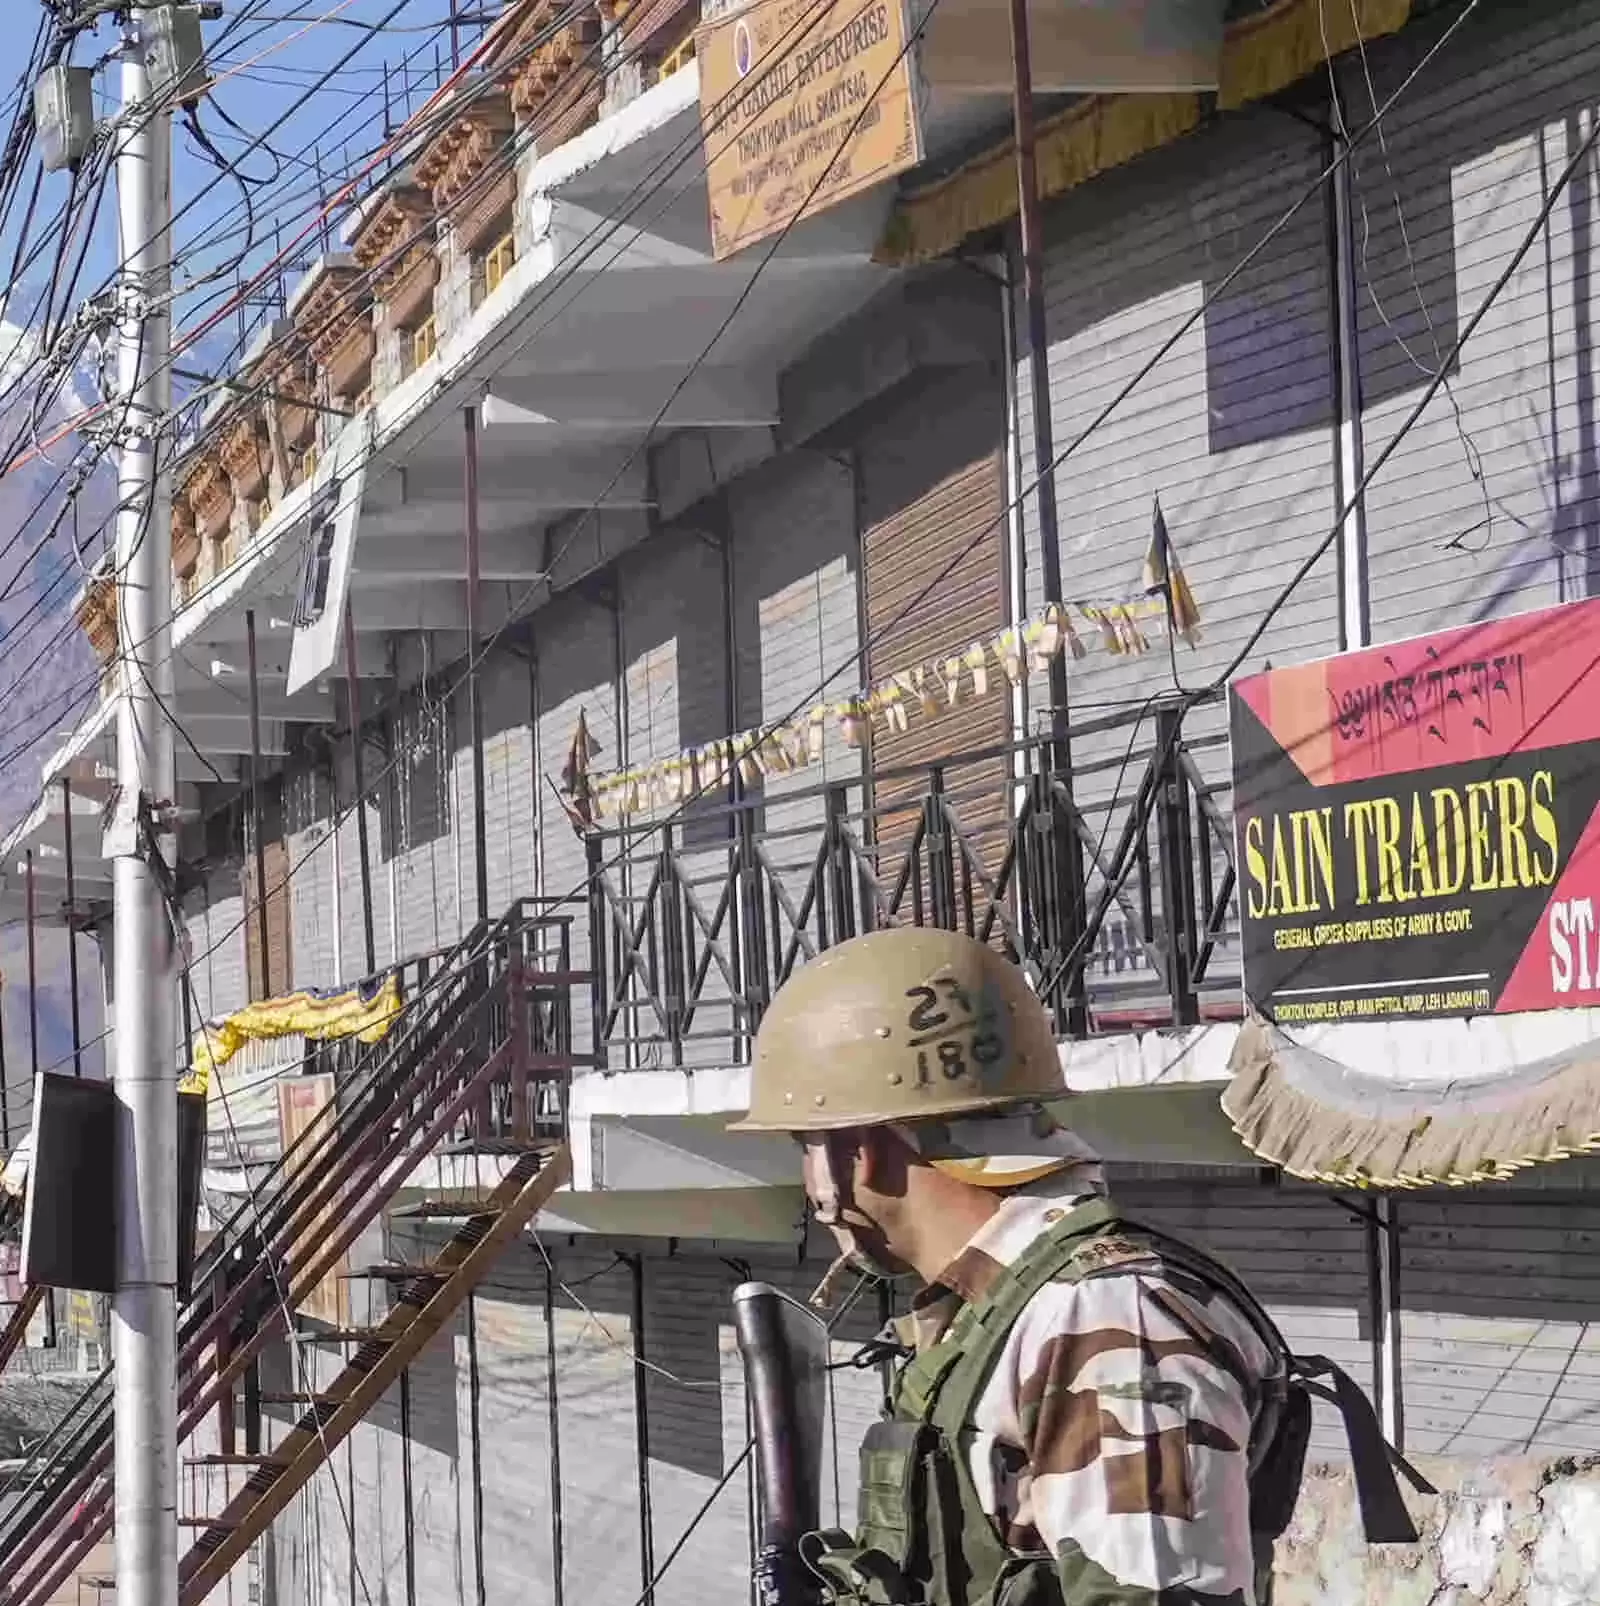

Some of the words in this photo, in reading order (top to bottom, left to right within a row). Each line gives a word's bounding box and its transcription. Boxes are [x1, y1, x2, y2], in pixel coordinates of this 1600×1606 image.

[796, 5, 889, 88] ENTERPRISE
[1245, 807, 1335, 919] SAIN
[1344, 770, 1560, 905] TRADERS
[1274, 925, 1314, 949] GENERAL
[1315, 922, 1344, 945] ORDER
[1344, 915, 1393, 942] SUPPLIERS
[1393, 915, 1406, 938] OF
[1407, 911, 1435, 936] ARMY
[1435, 911, 1444, 933] &
[1550, 897, 1600, 992] ST
[1425, 993, 1440, 1010] LEH
